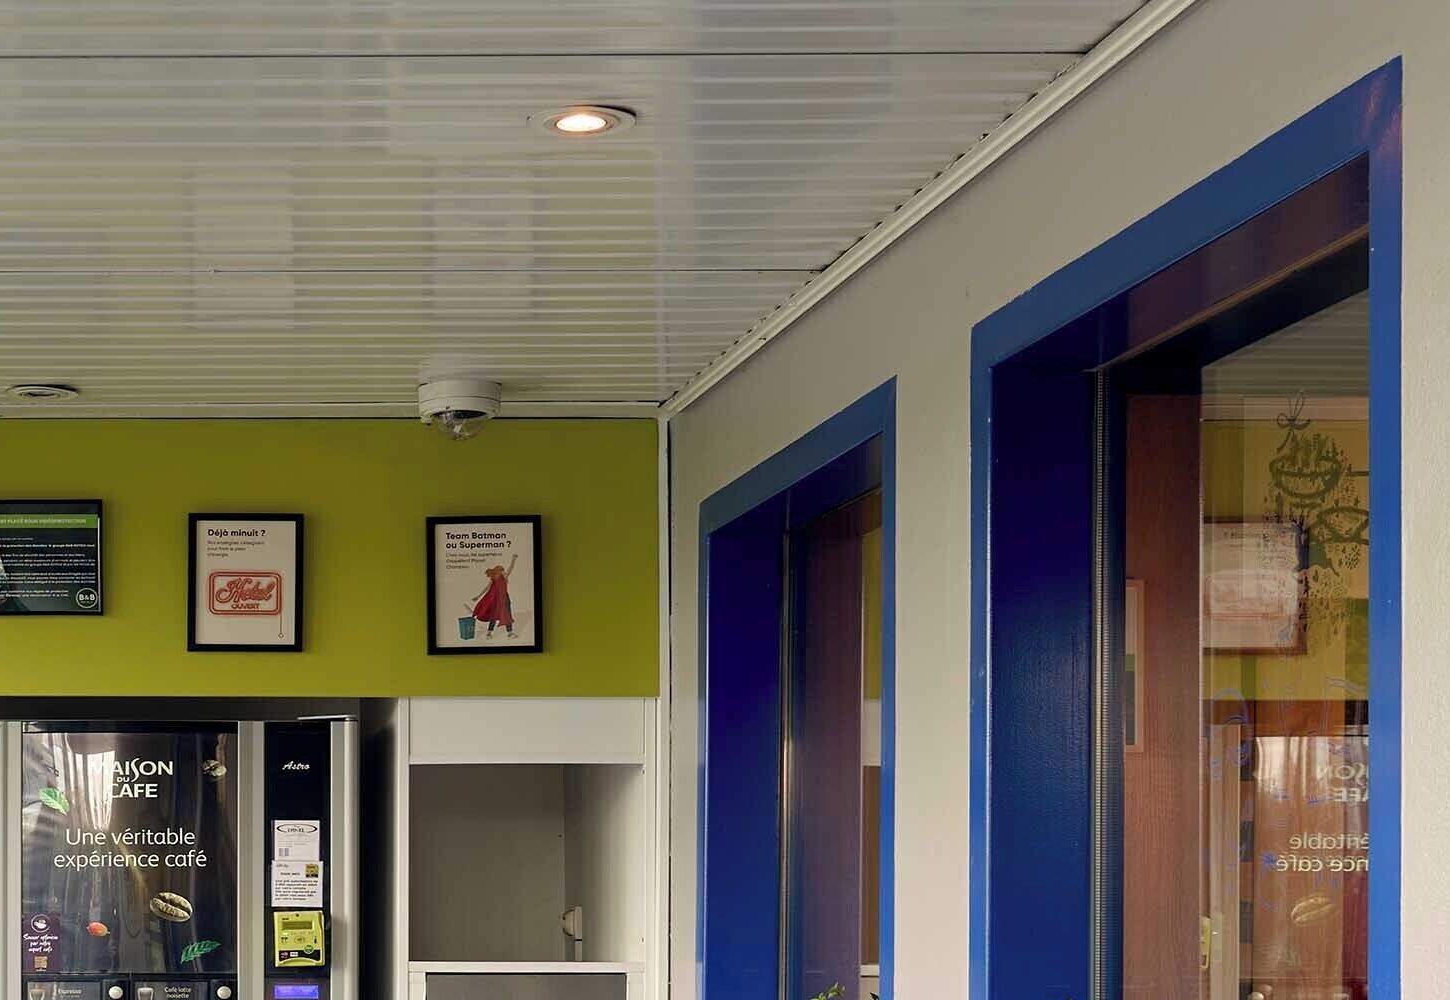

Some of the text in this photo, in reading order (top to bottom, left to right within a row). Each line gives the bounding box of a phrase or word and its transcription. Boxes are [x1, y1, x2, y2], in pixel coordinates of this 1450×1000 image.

[208, 529, 228, 538] Déjà
[460, 541, 504, 550] Superman
[282, 760, 310, 770] Astro
[110, 783, 158, 798] CAFE
[66, 828, 196, 846] Une véritable
[53, 850, 208, 872] expérience café
